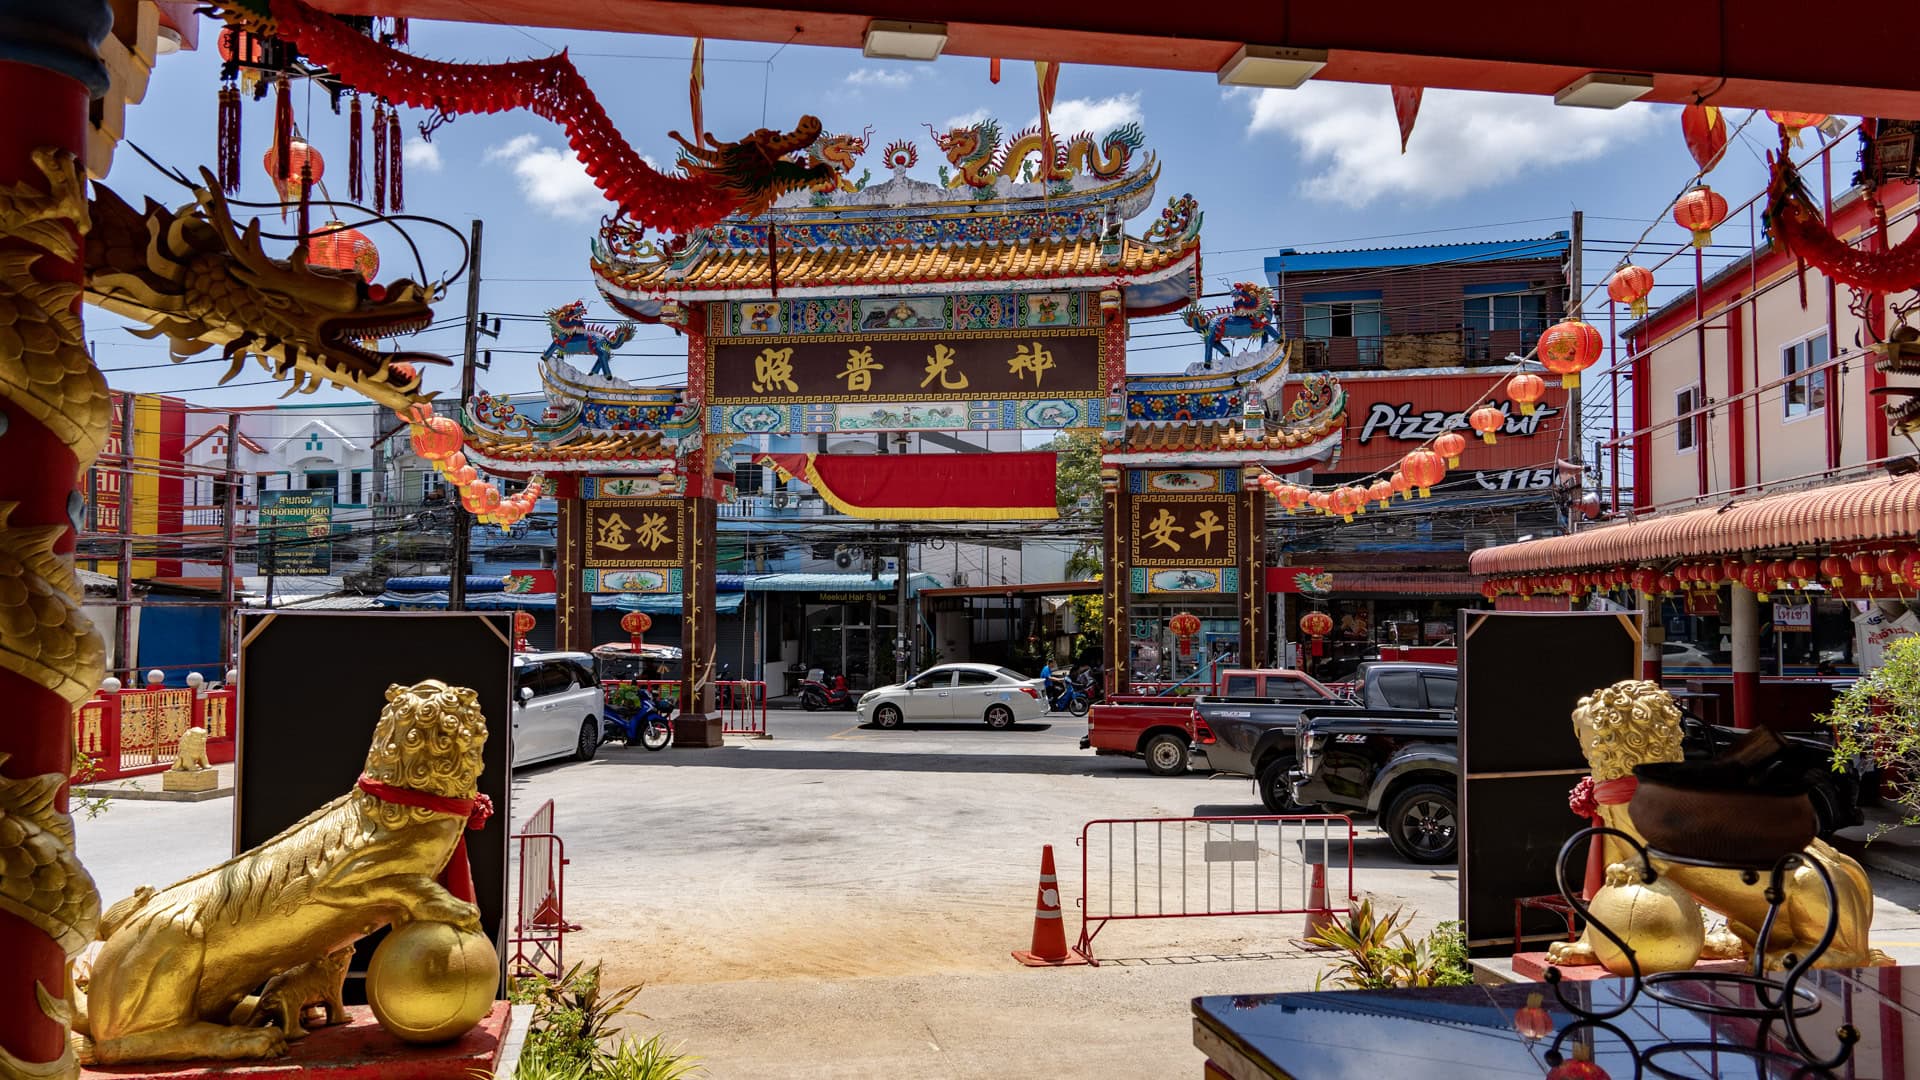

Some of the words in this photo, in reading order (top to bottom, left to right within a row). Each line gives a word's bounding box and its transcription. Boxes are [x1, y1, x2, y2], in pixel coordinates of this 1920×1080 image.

[1360, 403, 1469, 442] Pizza
[1499, 469, 1562, 490] 115
[848, 592, 865, 601] Hair
